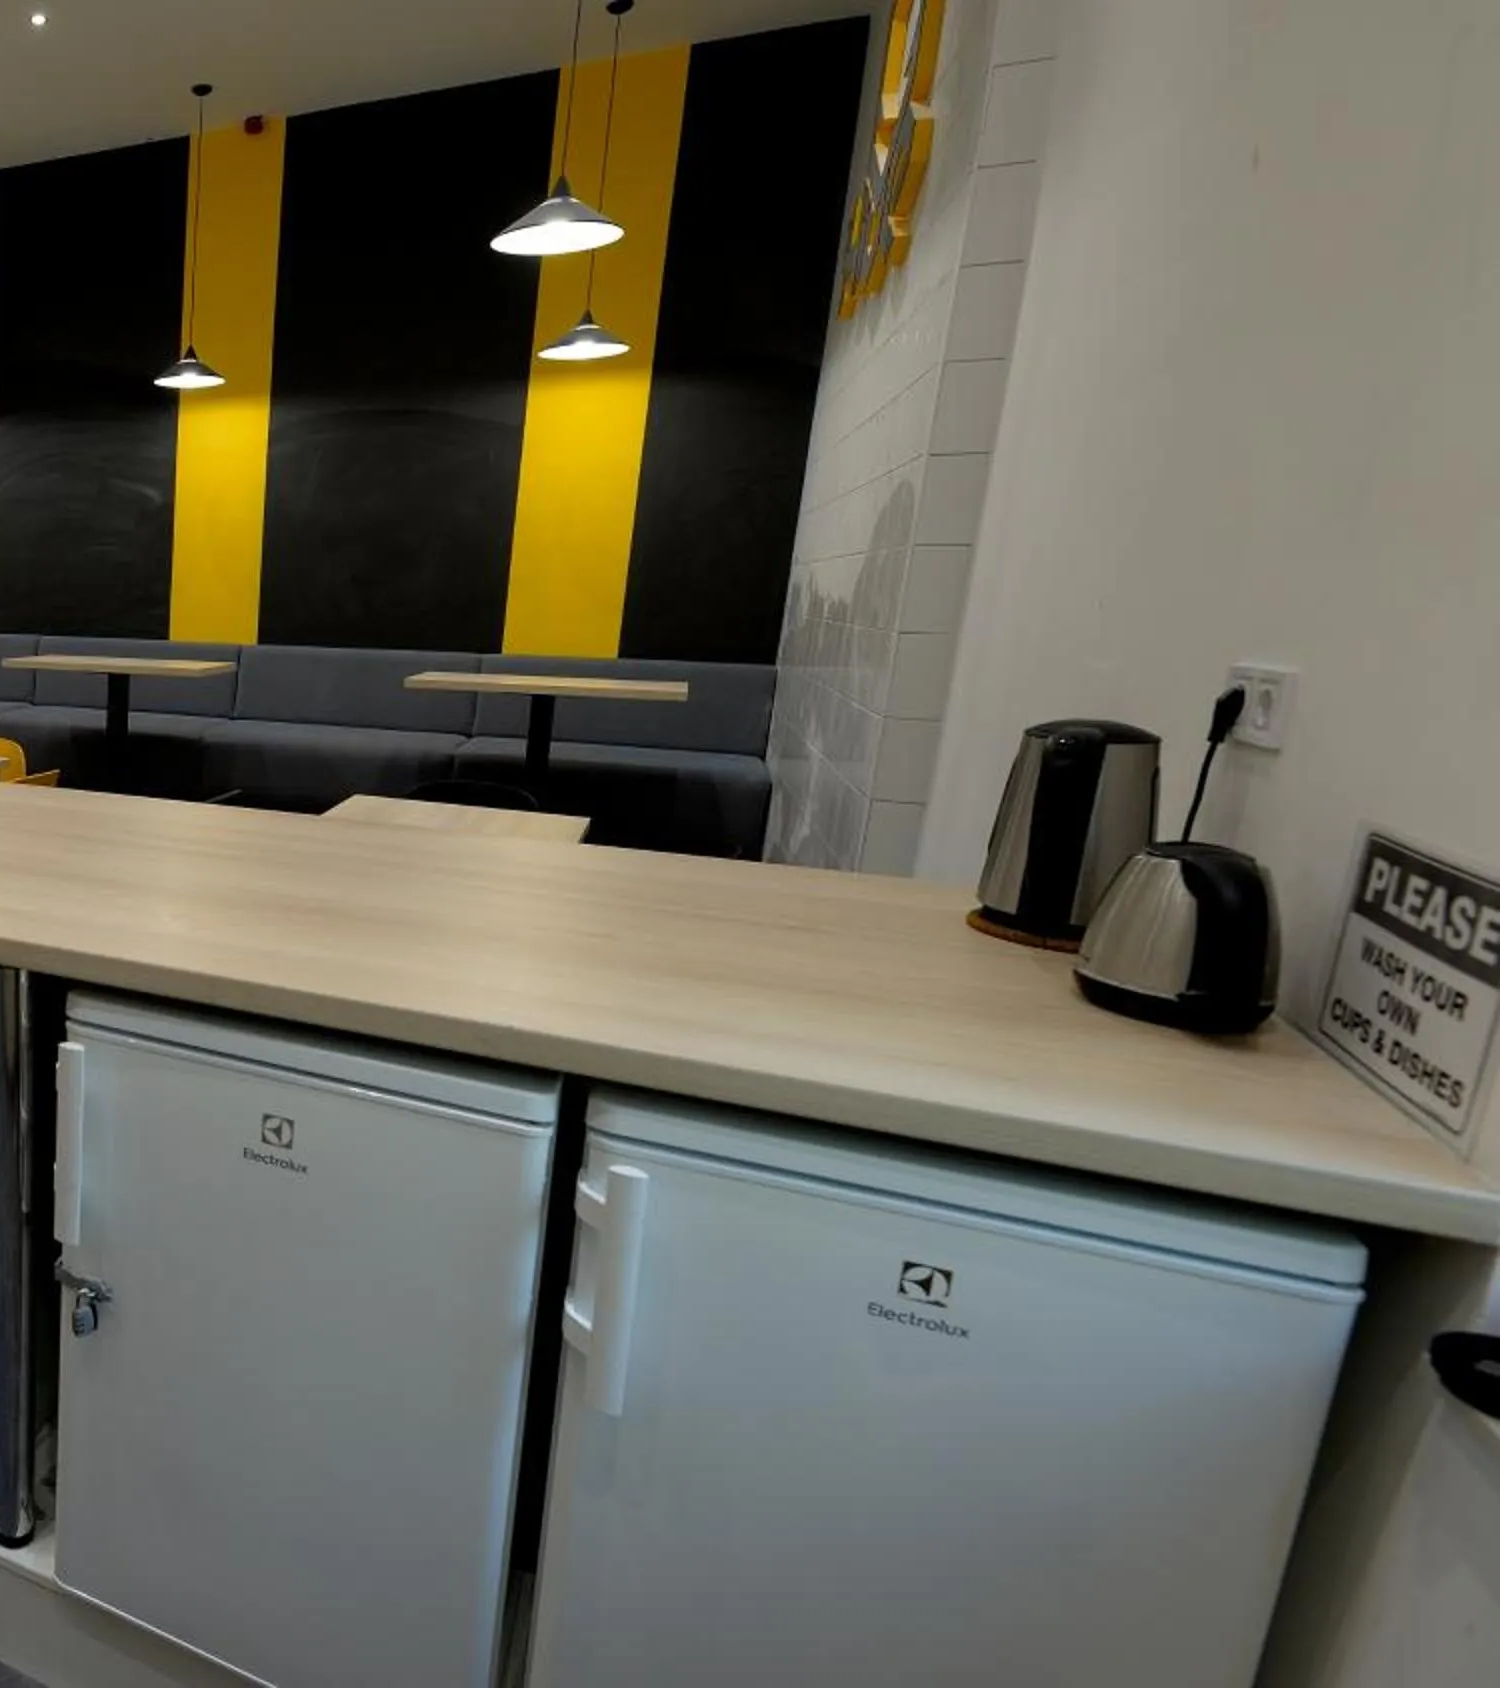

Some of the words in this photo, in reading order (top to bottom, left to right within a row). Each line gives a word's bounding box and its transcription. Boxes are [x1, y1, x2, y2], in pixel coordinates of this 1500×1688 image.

[1364, 857, 1500, 966] PLEASE
[1360, 937, 1407, 986] WASH
[1410, 965, 1468, 1022] YOUR
[1377, 990, 1421, 1036] OWN
[1331, 997, 1372, 1043] CUPS
[1371, 1028, 1385, 1055] &
[1387, 1040, 1464, 1108] DISHES
[243, 1147, 308, 1173] Electrolux
[867, 1301, 970, 1339] Electrolux
